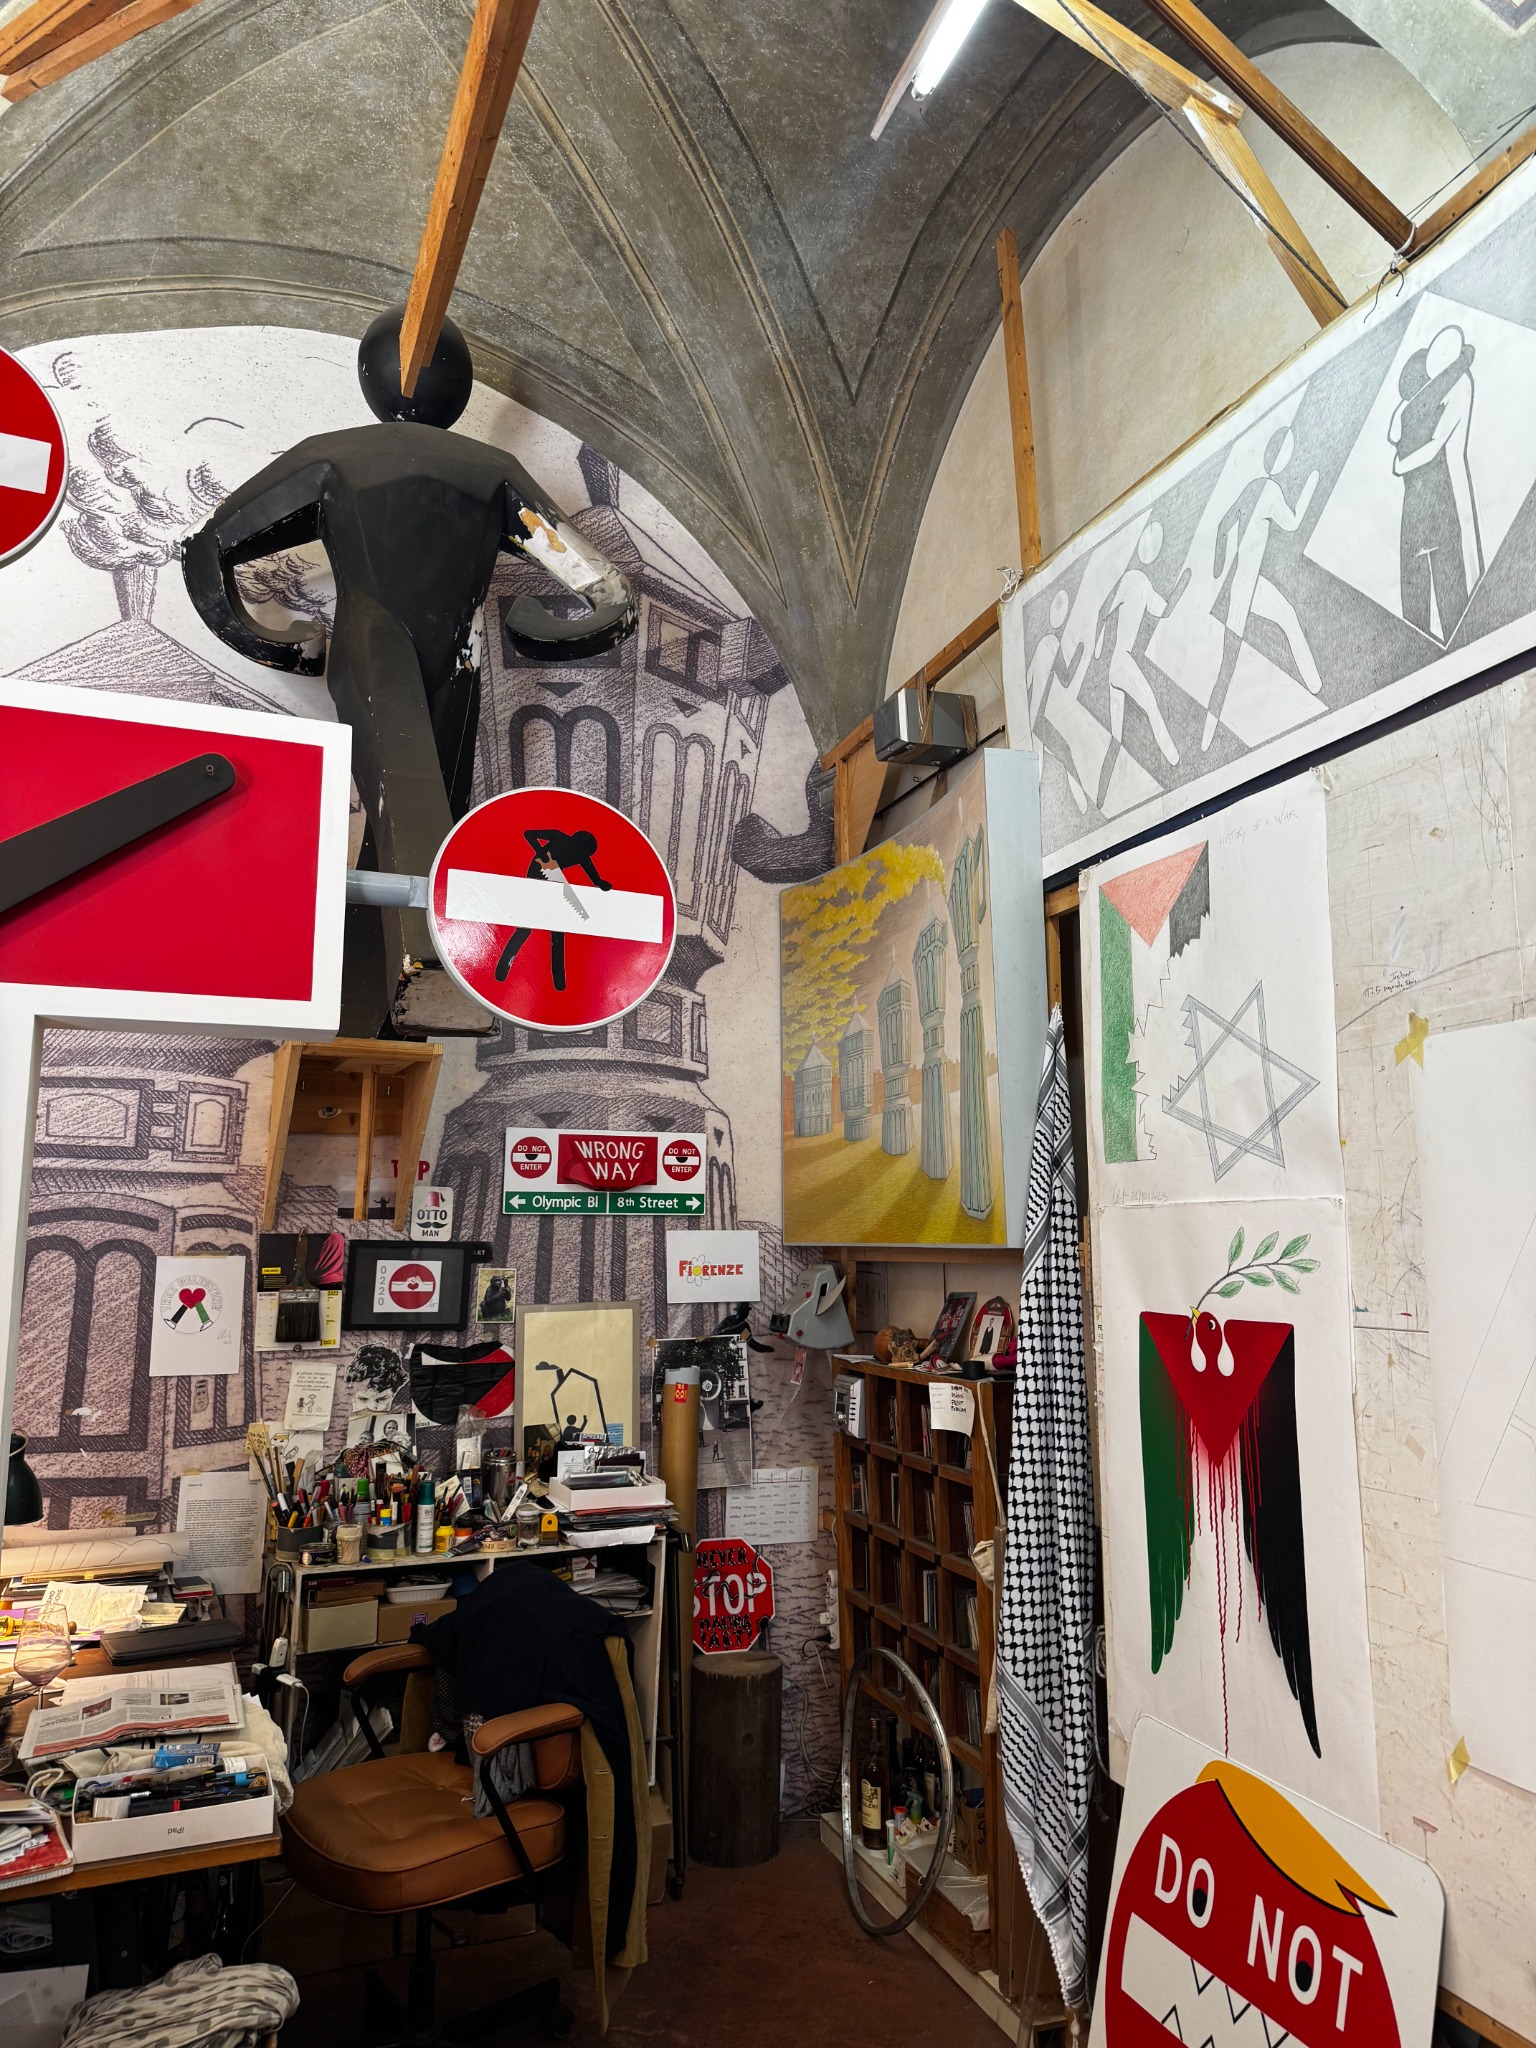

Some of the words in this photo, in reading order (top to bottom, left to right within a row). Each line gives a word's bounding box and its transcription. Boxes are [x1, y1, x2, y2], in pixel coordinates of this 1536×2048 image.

[517, 1144, 528, 1152] DO
[531, 1145, 547, 1153] NOT
[574, 1140, 646, 1160] WRONG
[668, 1147, 679, 1155] DO
[682, 1148, 697, 1156] NOT
[519, 1163, 543, 1171] ENTER
[587, 1162, 640, 1181] WAY
[532, 1195, 582, 1210] Olympic
[587, 1196, 599, 1208] Bl
[617, 1197, 635, 1208] 8th
[639, 1197, 679, 1209] Street
[416, 1209, 448, 1221] OTTO
[161, 1283, 178, 1313] FREE
[177, 1274, 222, 1312] PALESTINE
[696, 1547, 750, 1569] NEVER
[699, 1614, 752, 1632] MAKING
[167, 1826, 185, 1836] iPad
[1154, 1833, 1215, 1928] DO
[1247, 1893, 1364, 2032] NOT
